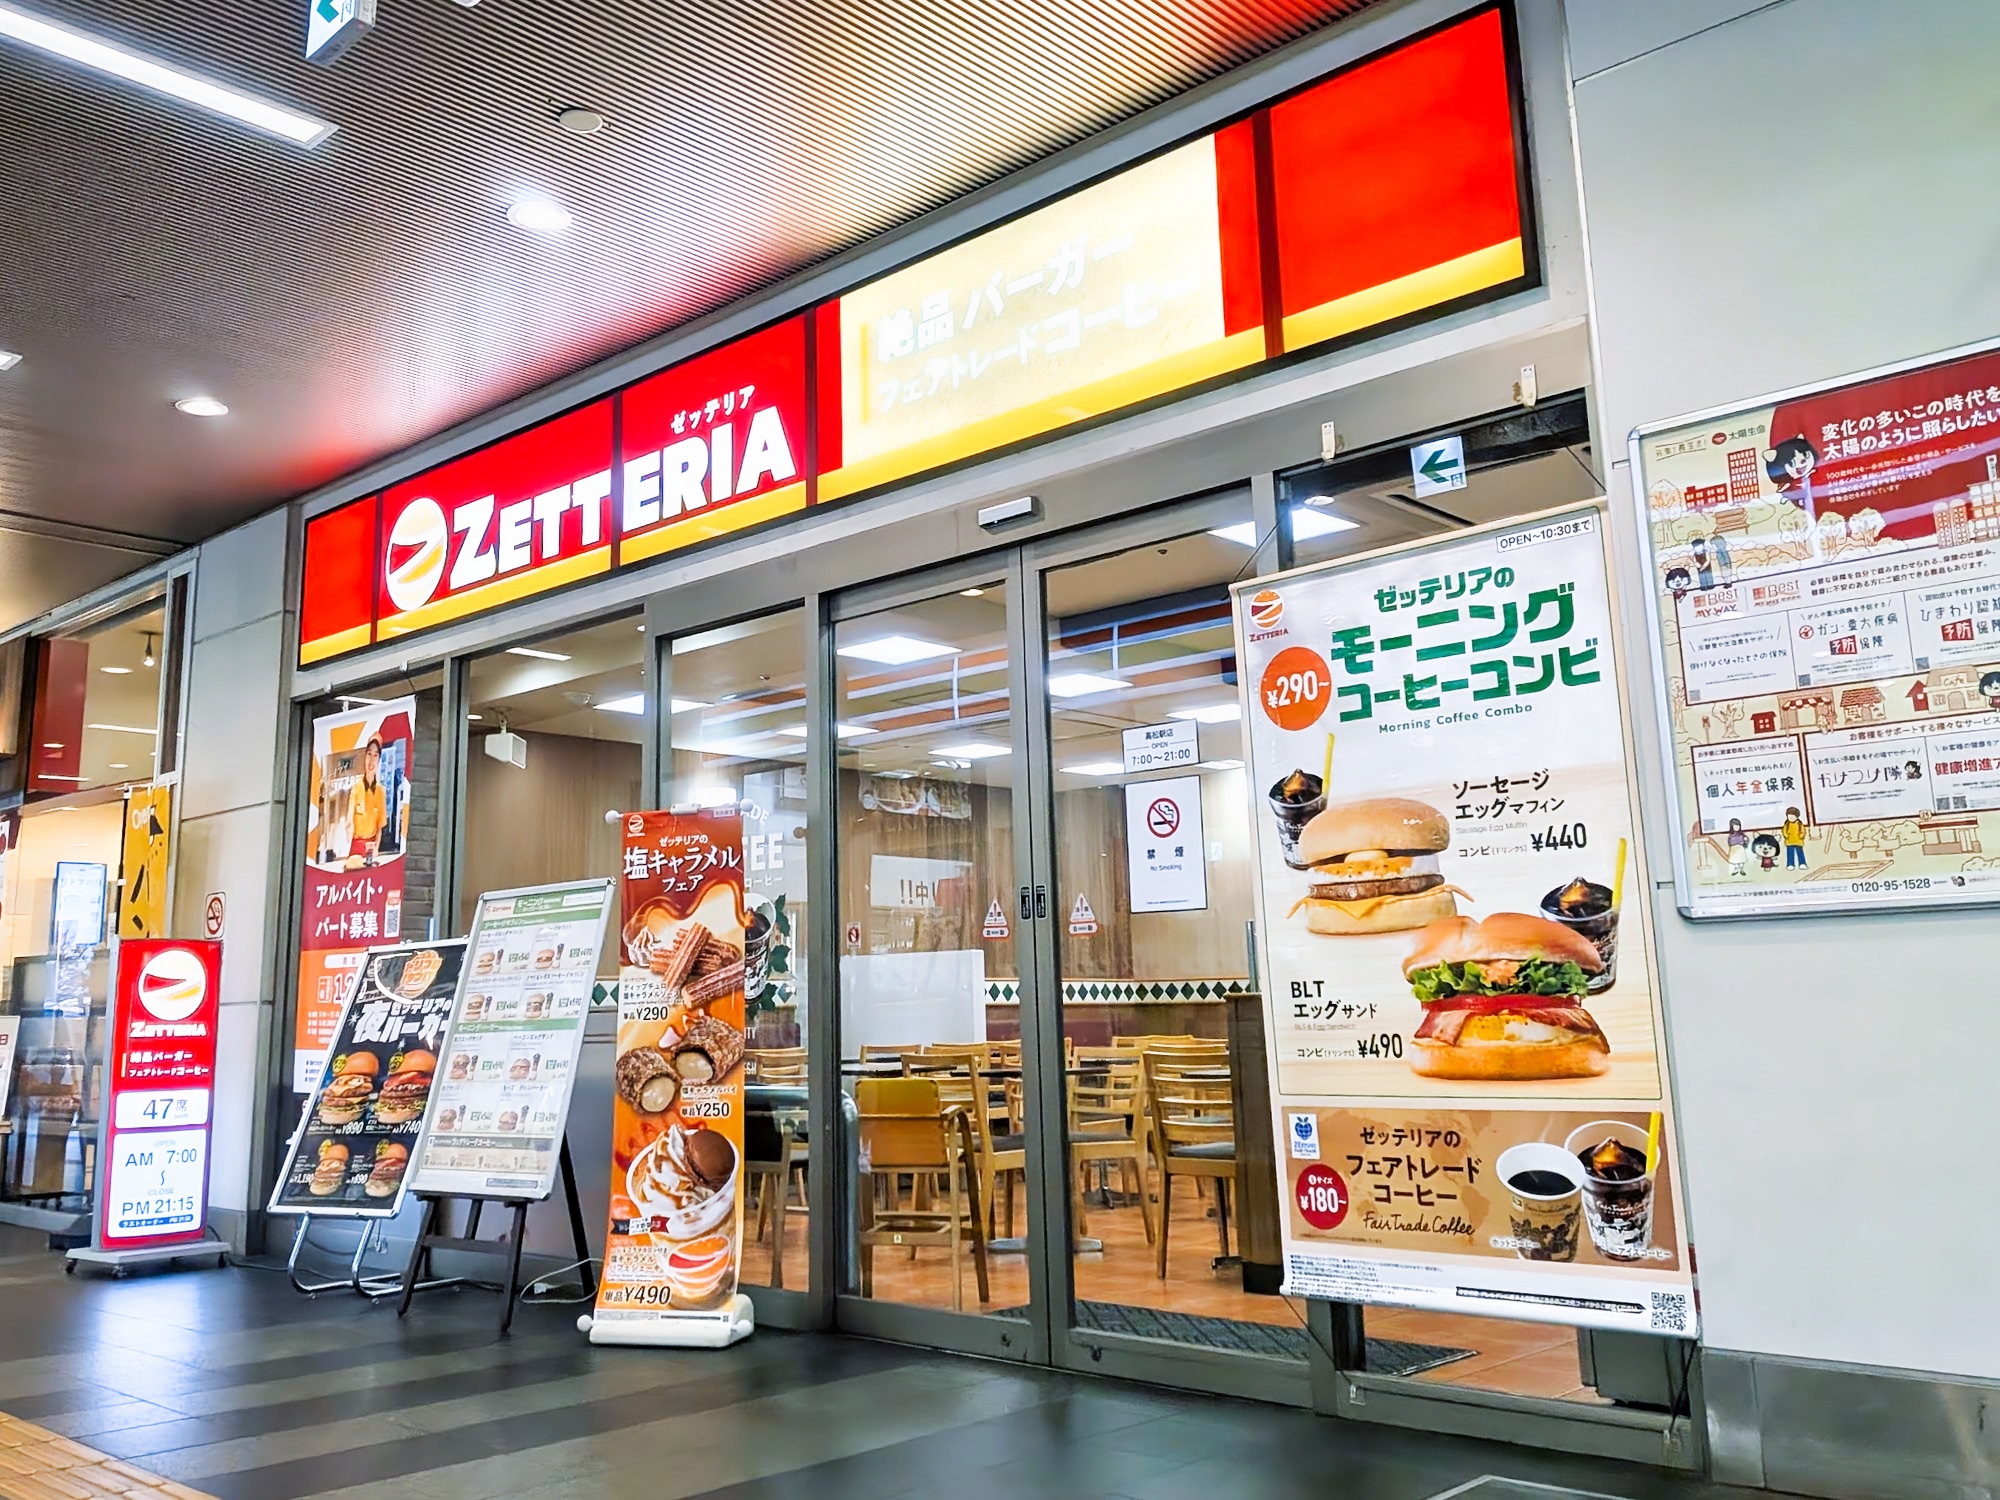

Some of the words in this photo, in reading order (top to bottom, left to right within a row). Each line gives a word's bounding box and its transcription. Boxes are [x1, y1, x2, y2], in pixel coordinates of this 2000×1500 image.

[670, 384, 756, 434] ゼッテリア
[1728, 424, 1766, 441] 太陽生命
[449, 405, 797, 590] ZETTERIA
[1374, 566, 1515, 613] ゼッテリアの
[1708, 589, 1738, 605] Best
[1768, 580, 1800, 598] Best
[1249, 628, 1289, 643] ZETTERIA
[1331, 582, 1575, 675] モーニング
[1943, 621, 1972, 640] 予防
[1831, 637, 1857, 654] 予防
[1859, 635, 1884, 650] 保険
[1337, 637, 1601, 723] コーヒーコンビ
[1379, 717, 1431, 734] Morning
[1436, 711, 1479, 726] Coffee
[1485, 702, 1533, 717] Combo
[1152, 741, 1169, 749] OPEN
[1453, 768, 1550, 799] ソーセージ
[1706, 776, 1796, 798] 個人年金保険
[1455, 796, 1565, 819] エッグマフィン
[659, 834, 709, 848] ゼッテリアの
[1530, 823, 1587, 852] ¥440
[623, 845, 741, 880] 塩キャラメル
[1159, 863, 1182, 872] Smoking
[661, 874, 705, 893] フェア
[1852, 878, 1931, 893] 0120-95-1528
[315, 910, 379, 940] パート募集
[1291, 980, 1325, 999] BLT
[636, 1006, 669, 1020] ¥290
[1294, 999, 1378, 1020] エッグサンド
[129, 1021, 207, 1038] ZETTERIA
[1357, 1033, 1403, 1059] ¥490
[143, 1098, 174, 1120] 47
[695, 1102, 730, 1117] ¥250
[153, 1139, 176, 1148] OPEN
[1360, 1126, 1461, 1148] ゼッテリアの
[125, 1152, 153, 1167] AM
[166, 1148, 197, 1164] 7:00
[1346, 1154, 1483, 1184] フェアトレード
[148, 1187, 174, 1196] CLOSE
[1374, 1184, 1458, 1207] コーヒー
[122, 1201, 150, 1216] PM
[155, 1196, 194, 1214] 21:15
[1363, 1211, 1392, 1231] Fair
[1391, 1212, 1431, 1233] Trade
[1432, 1215, 1476, 1236] Coffee
[1619, 1248, 1672, 1258] アイスコーヒー
[624, 1285, 672, 1305] ¥490
